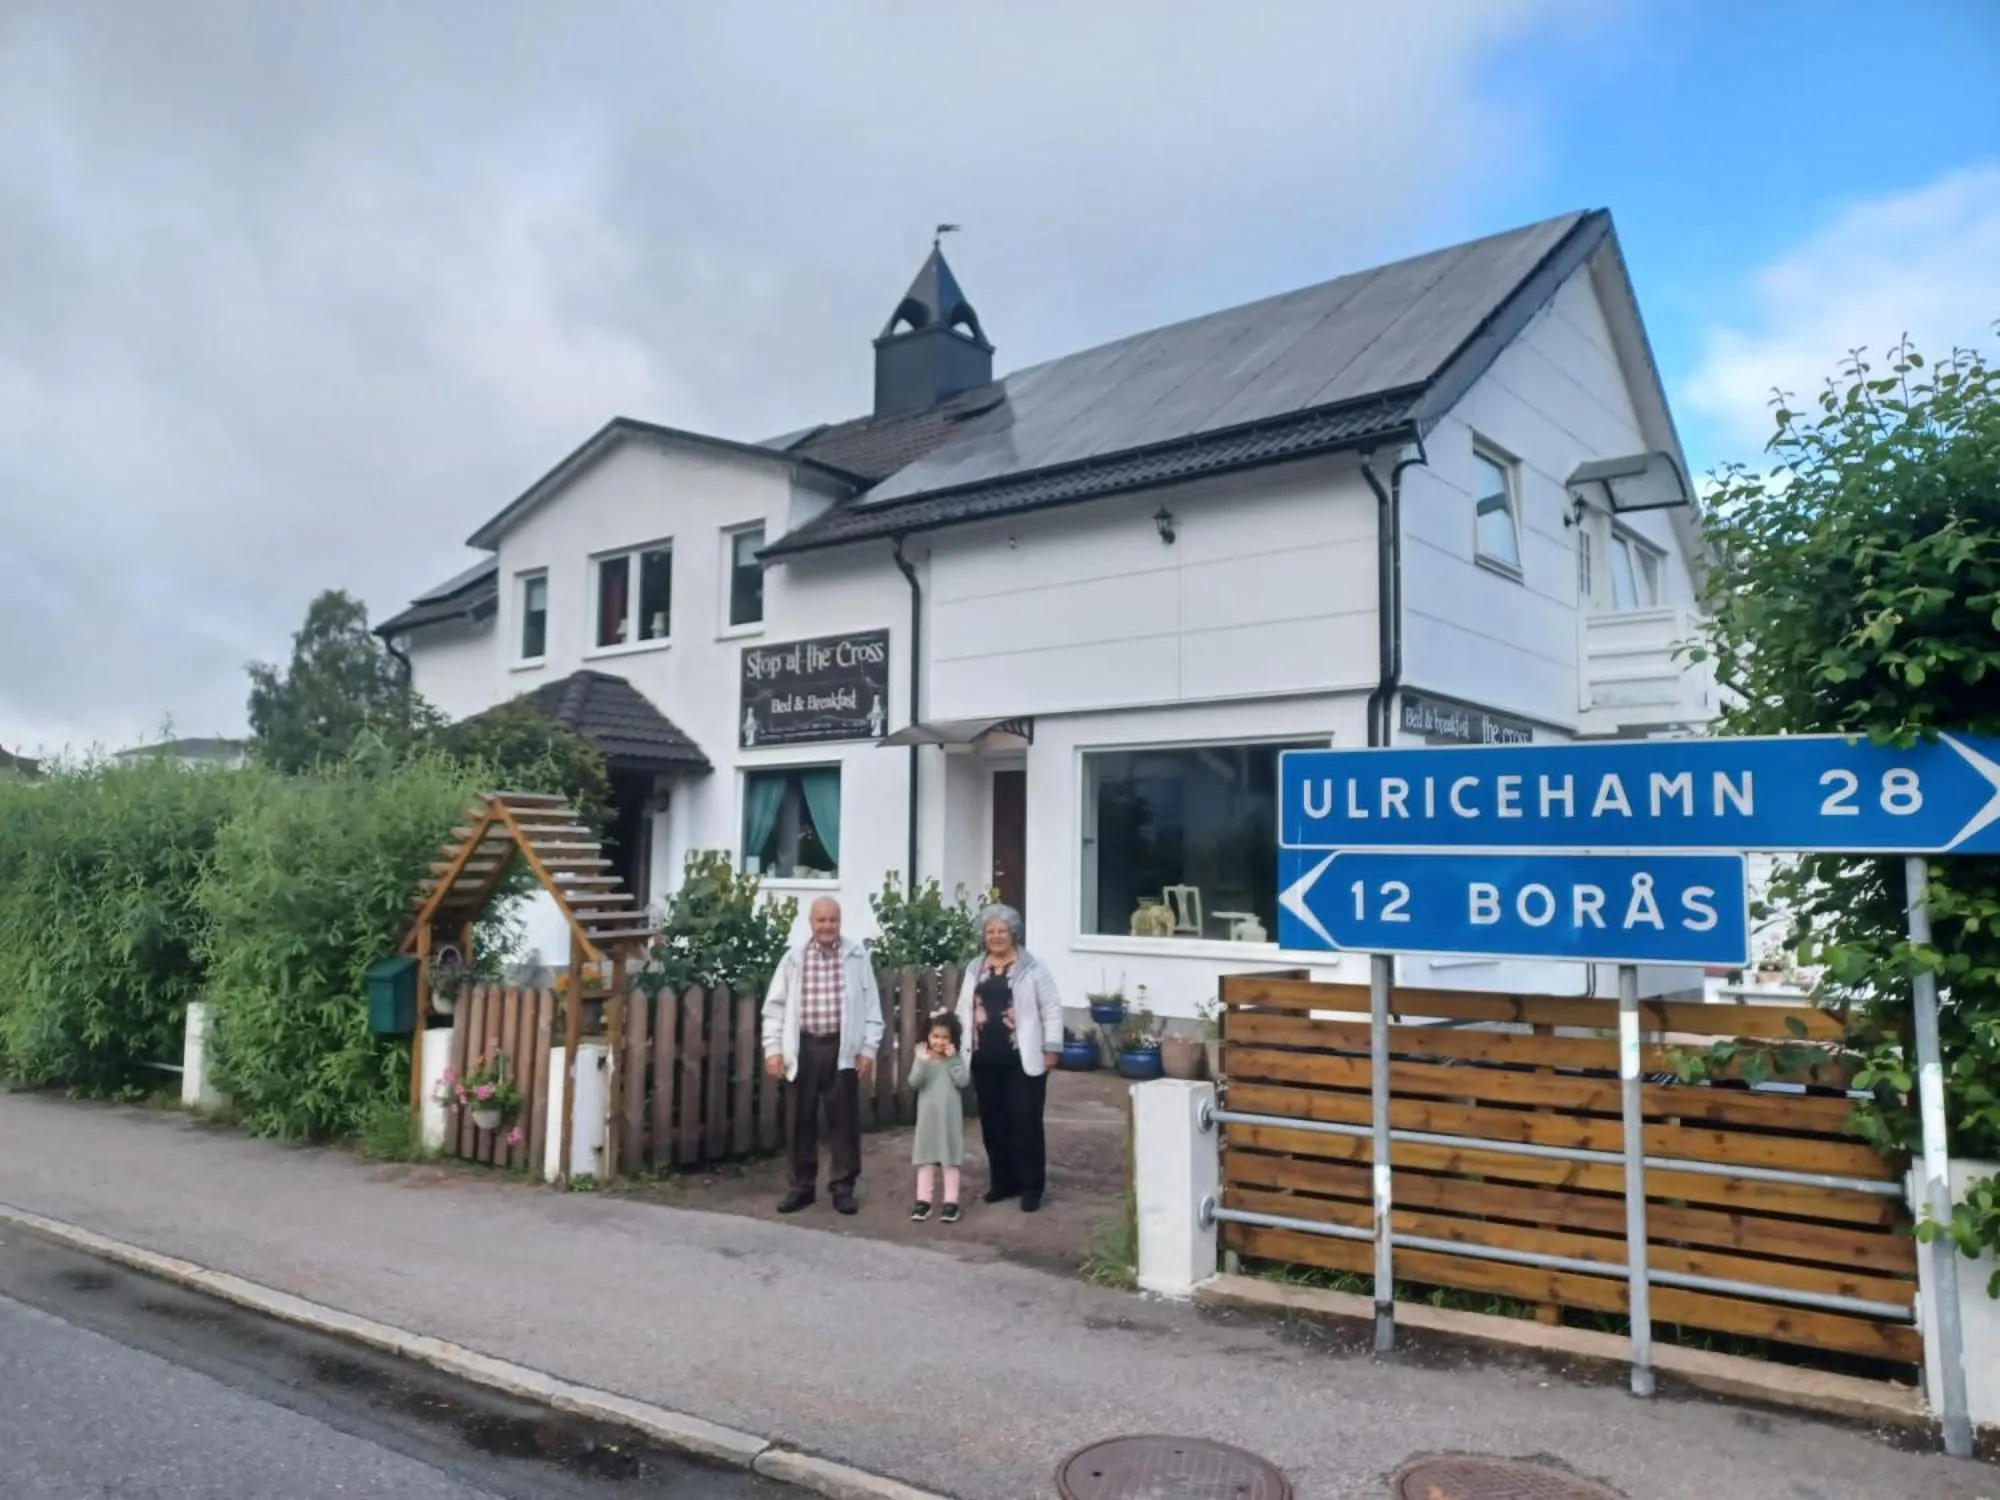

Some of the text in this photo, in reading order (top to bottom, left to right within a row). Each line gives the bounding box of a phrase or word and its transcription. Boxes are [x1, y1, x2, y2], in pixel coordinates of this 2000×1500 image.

[746, 640, 885, 680] Stop at the Cross
[770, 687, 857, 714] Bed & Breakfast
[1405, 703, 1423, 729] Bed
[1303, 769, 1923, 818] ULRICEHAMN 28
[1351, 872, 1719, 931] 12 BORÅS
